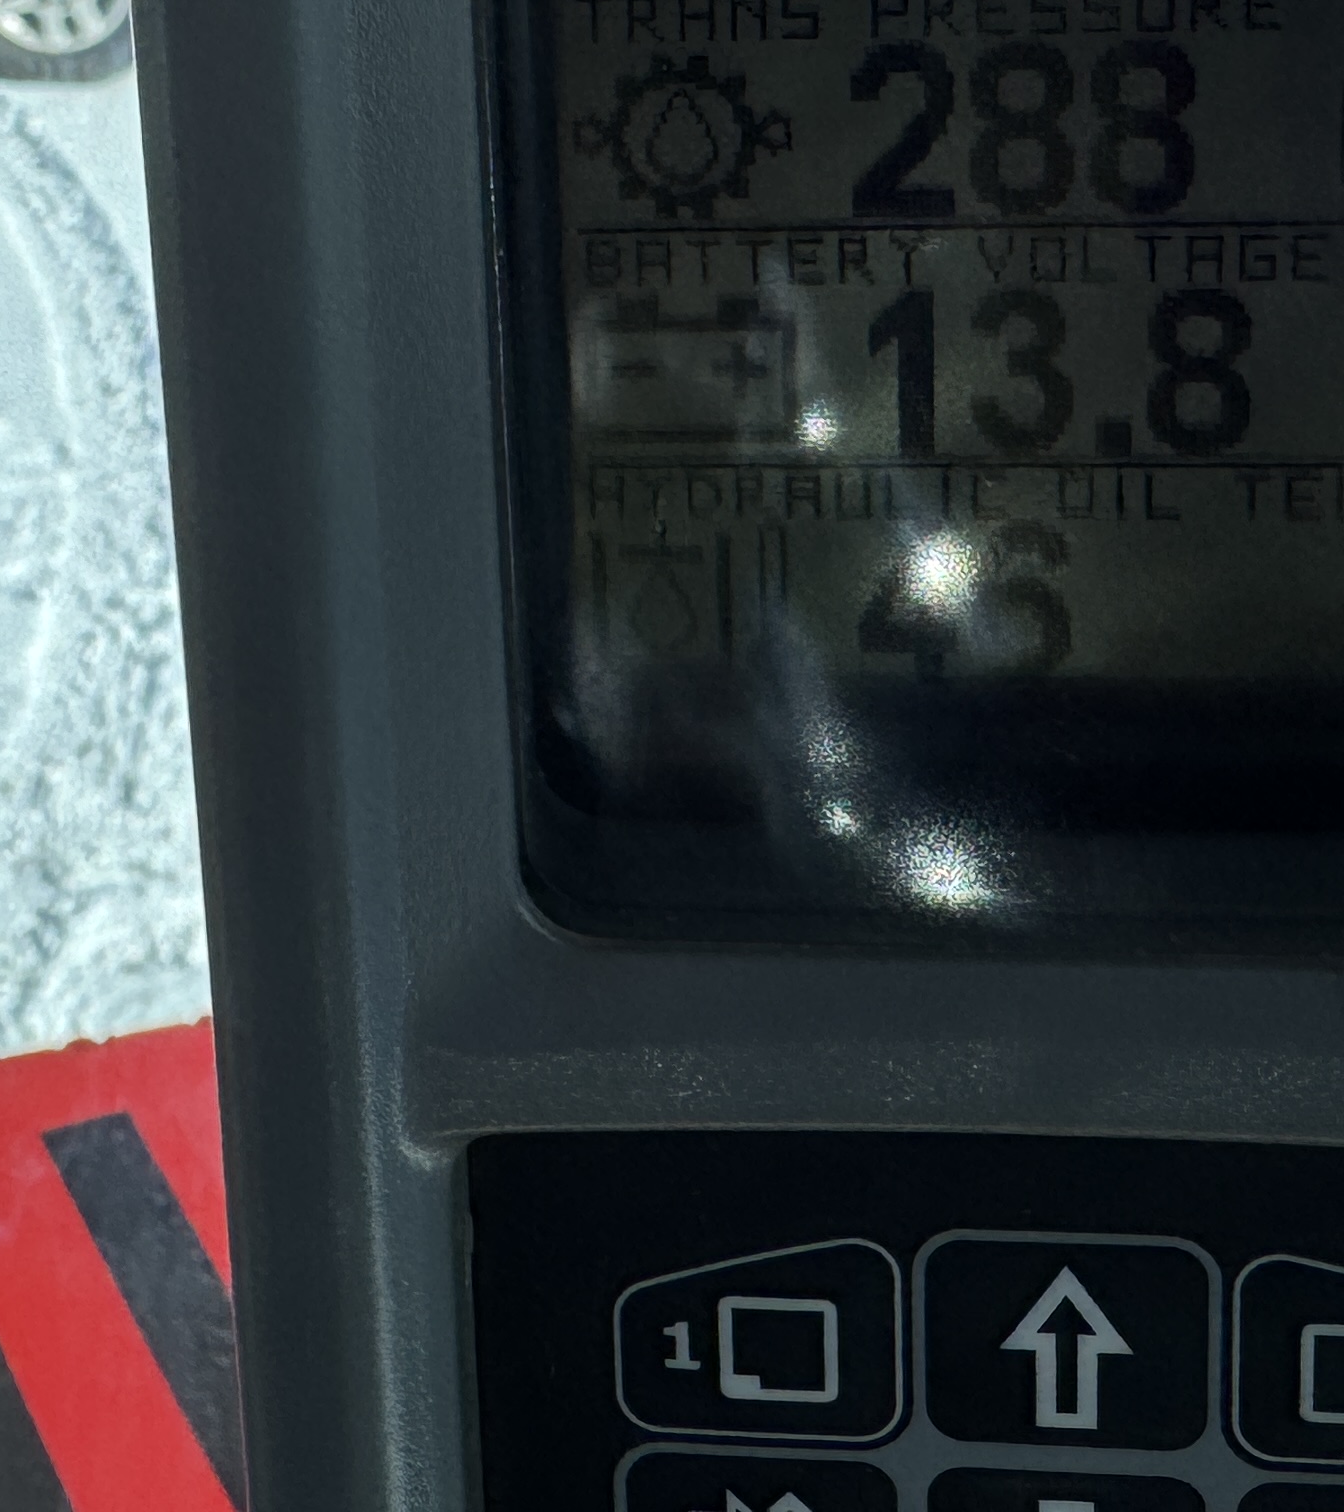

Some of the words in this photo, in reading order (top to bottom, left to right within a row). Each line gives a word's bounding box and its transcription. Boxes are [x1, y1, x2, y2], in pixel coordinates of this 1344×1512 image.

[849, 41, 1196, 217] 288
[586, 235, 922, 288] BATTERY
[977, 232, 1330, 283] VOLTAGE
[867, 285, 1251, 459] 13.8
[587, 470, 995, 524] HYDRAULIC
[1059, 473, 1183, 521] OIL
[662, 1321, 702, 1370] 1
